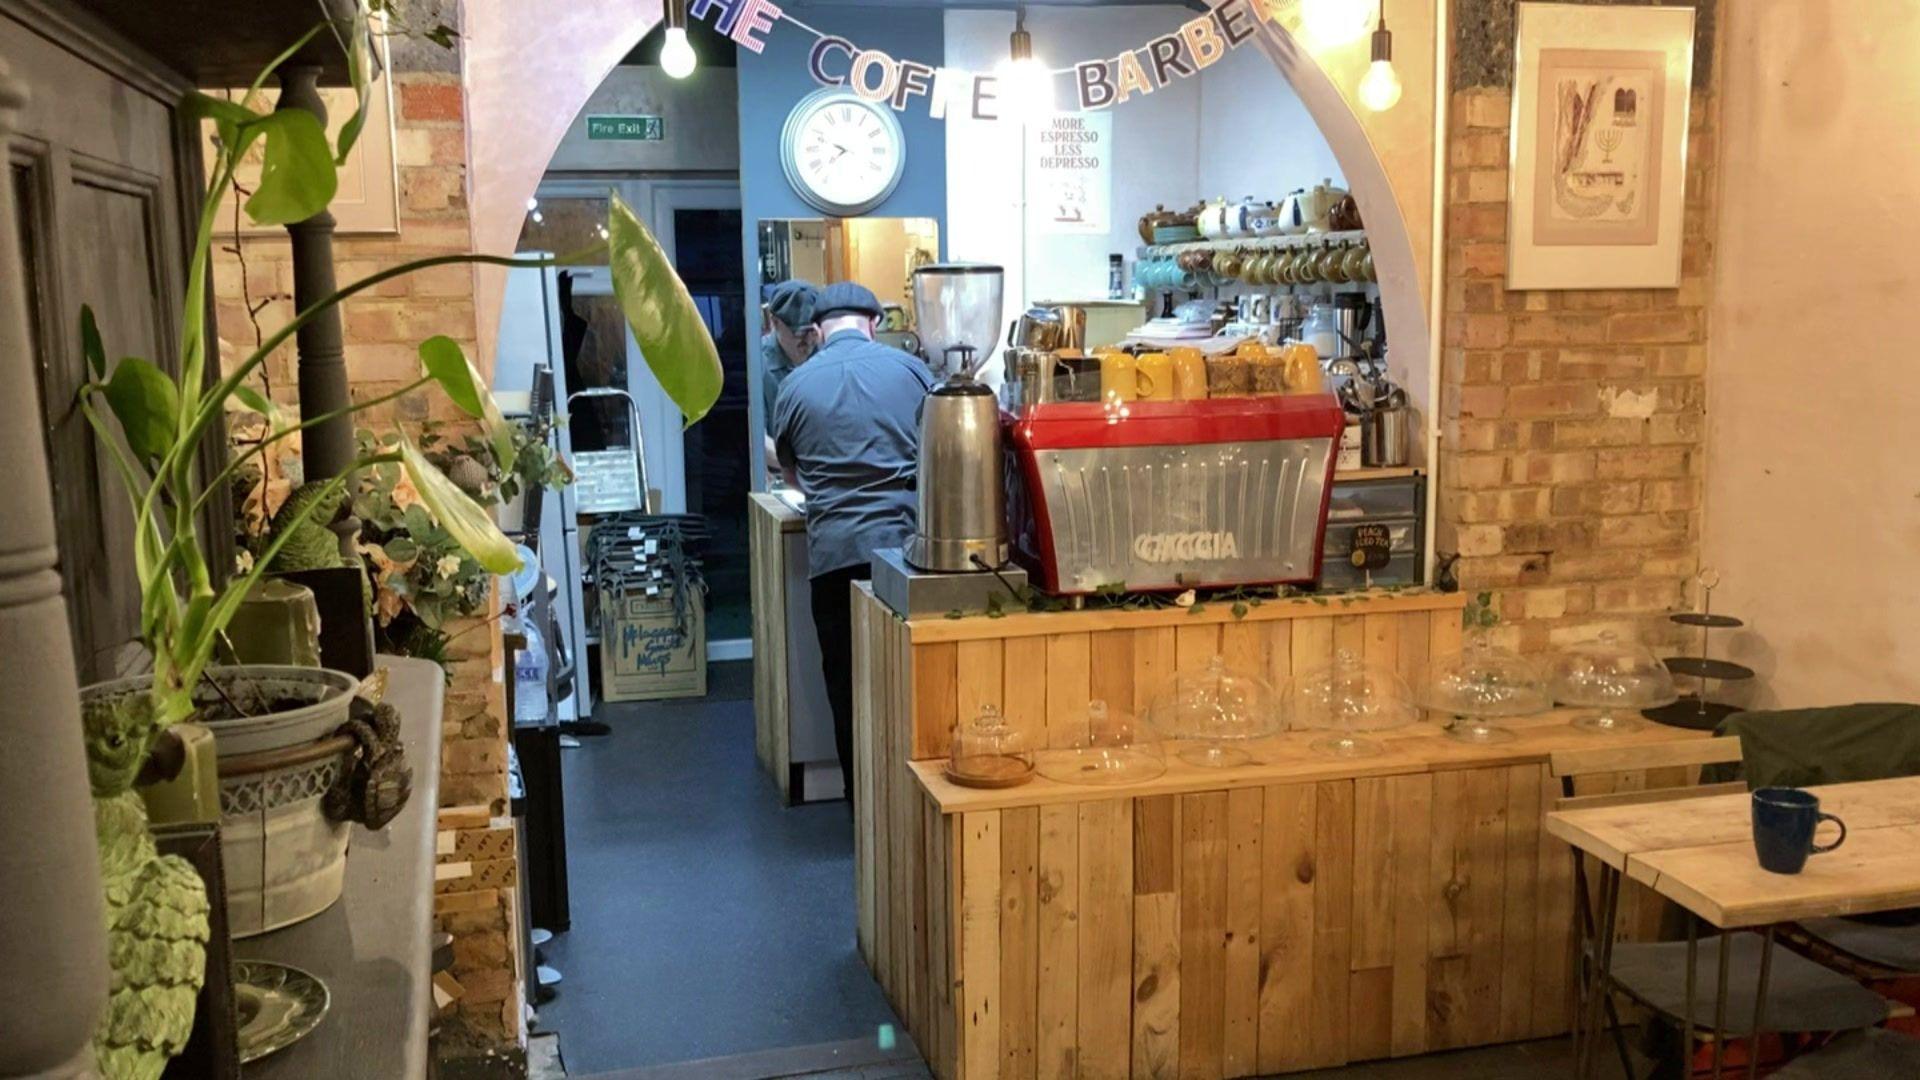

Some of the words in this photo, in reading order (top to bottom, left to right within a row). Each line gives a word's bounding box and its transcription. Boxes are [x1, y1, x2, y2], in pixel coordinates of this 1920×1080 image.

[592, 123, 614, 135] Fire
[618, 123, 641, 135] Exit
[1051, 117, 1085, 130] MORE
[1040, 131, 1099, 143] ESPRESSO
[1054, 144, 1083, 156] LESS
[1040, 157, 1100, 169] DEPRESSO
